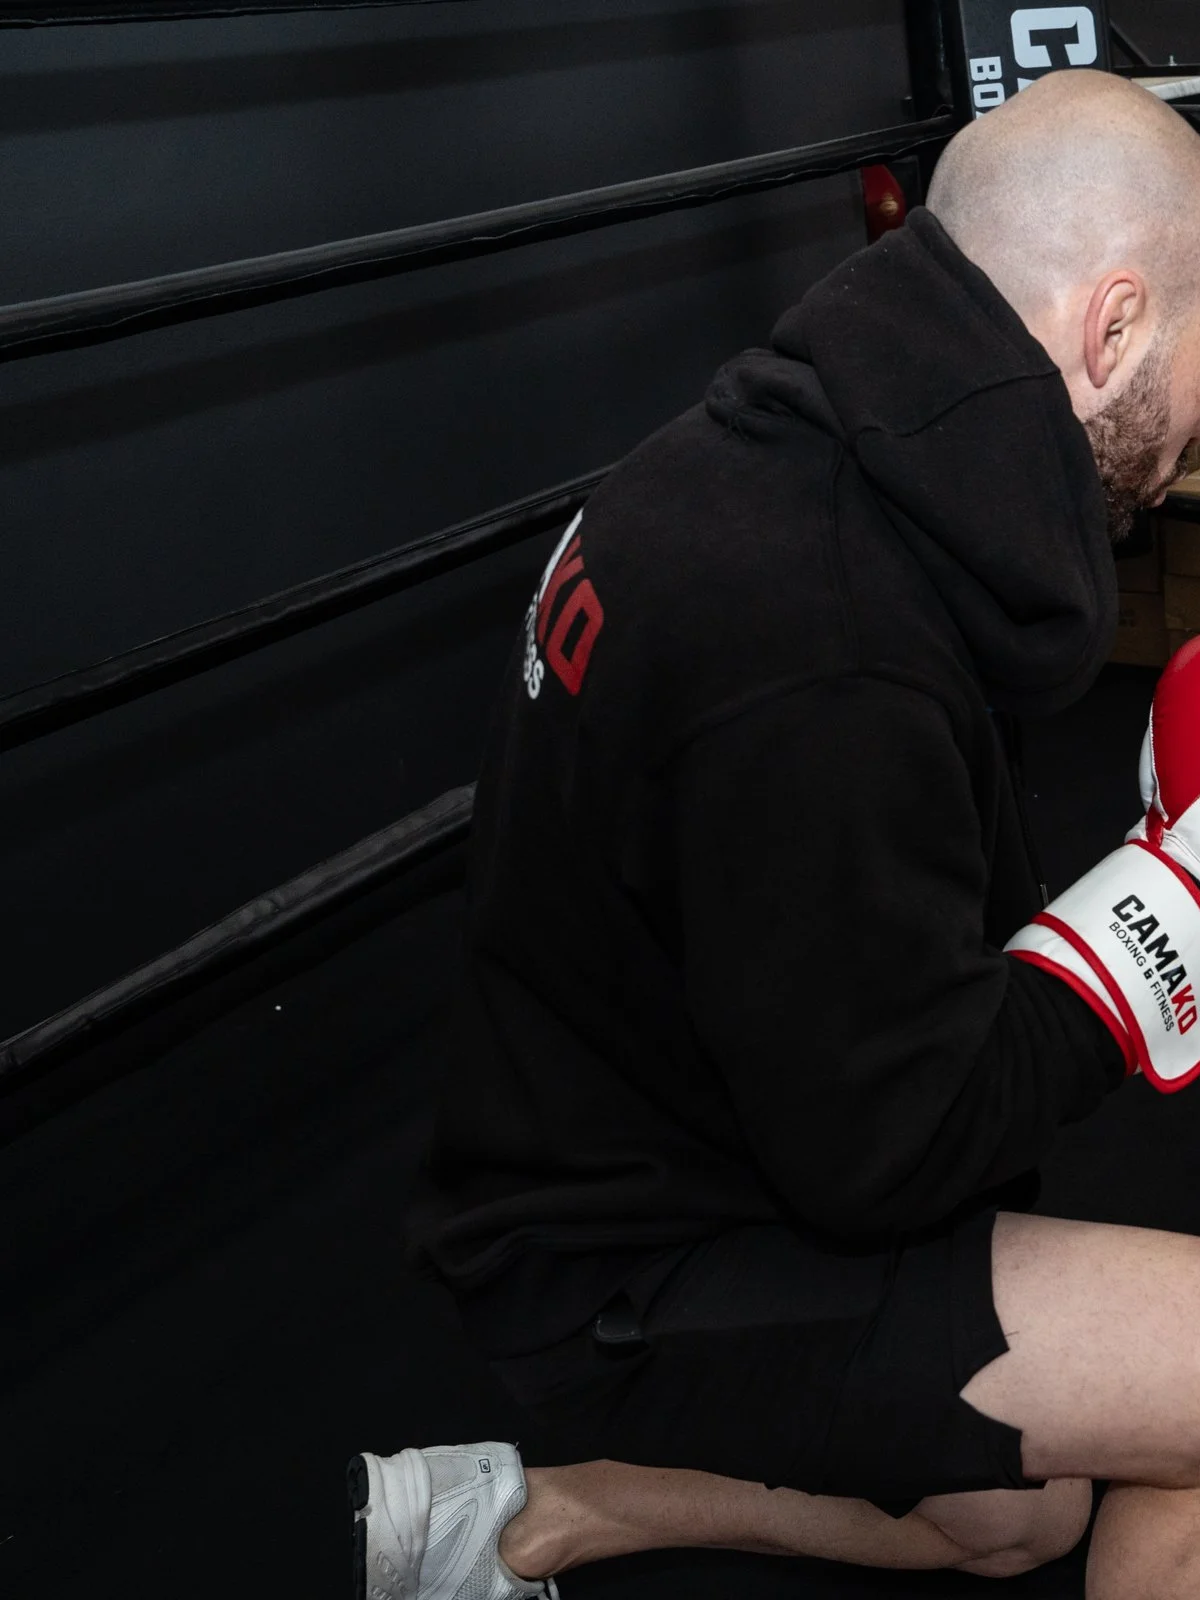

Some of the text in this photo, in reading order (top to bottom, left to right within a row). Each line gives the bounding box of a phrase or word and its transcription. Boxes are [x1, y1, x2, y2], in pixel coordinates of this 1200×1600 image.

[969, 56, 1006, 119] BO
[1108, 921, 1175, 1032] BOXING & FITNESS
[1111, 894, 1198, 1036] CAMAKO
